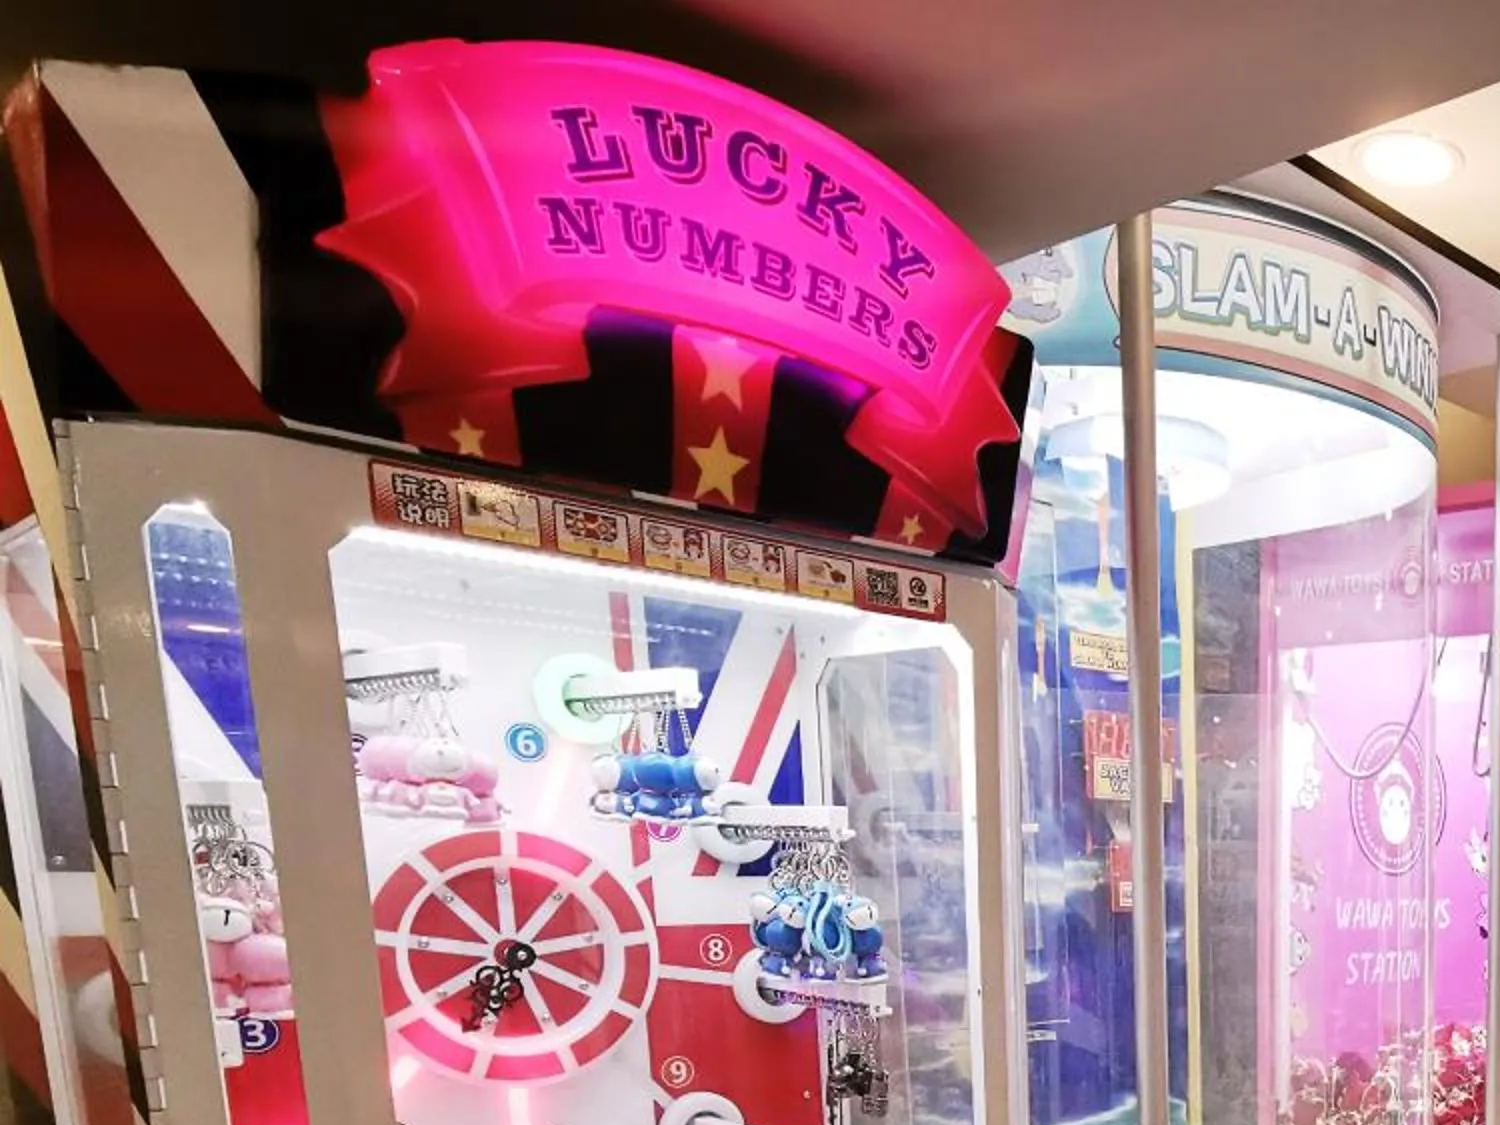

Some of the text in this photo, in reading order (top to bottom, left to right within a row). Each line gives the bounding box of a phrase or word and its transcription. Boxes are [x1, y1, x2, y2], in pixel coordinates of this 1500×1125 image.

[551, 106, 935, 300] LUCKY
[539, 197, 937, 370] NUMBERS
[1153, 239, 1438, 410] SLAM-A-WIN
[392, 472, 449, 501] 玩法
[398, 500, 450, 530] 说明
[1451, 559, 1493, 584] STAT
[517, 730, 536, 757] 6
[1336, 897, 1394, 930] WAWA
[707, 938, 725, 961] 8
[1345, 951, 1421, 985] STATION
[243, 1020, 267, 1048] 3
[670, 1061, 687, 1084] 9
